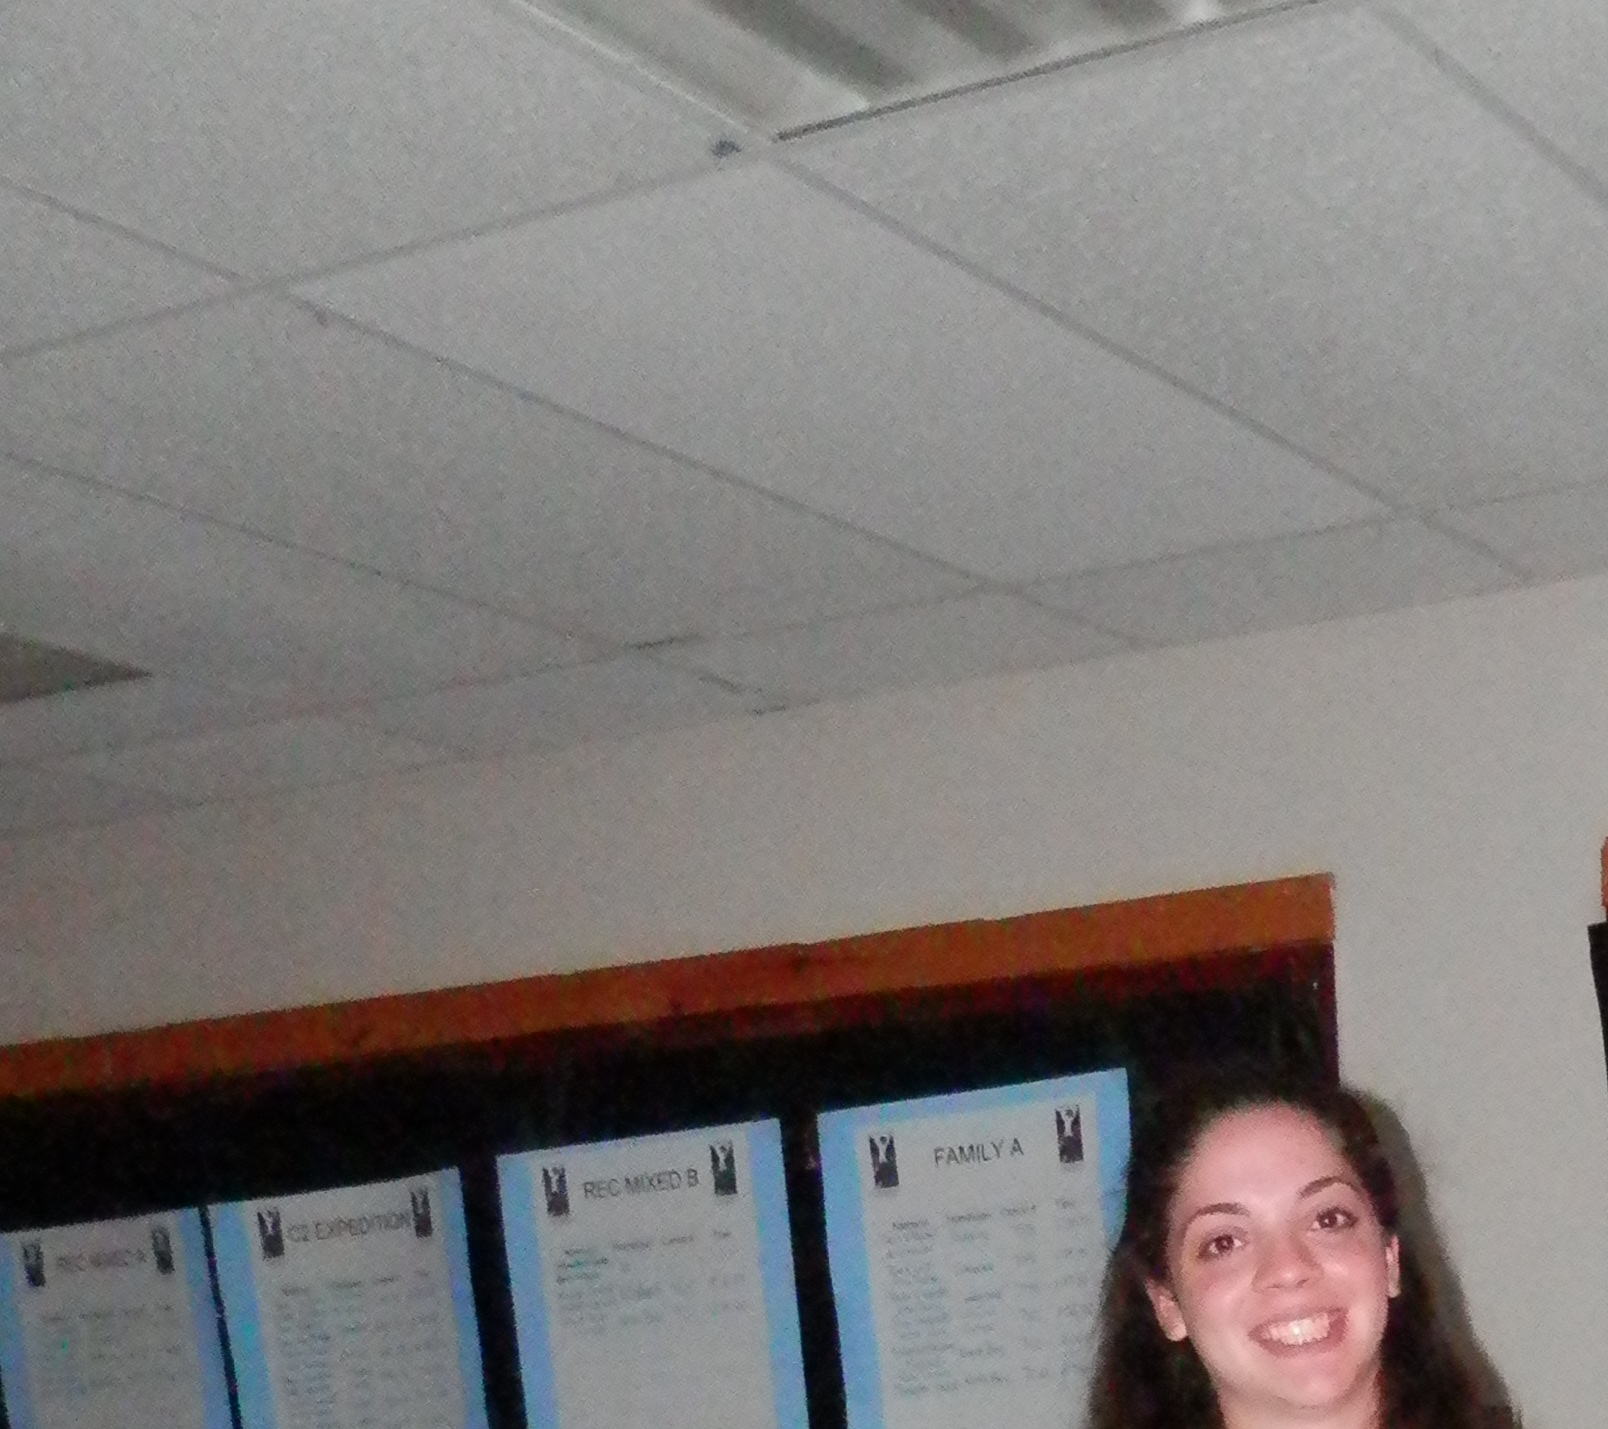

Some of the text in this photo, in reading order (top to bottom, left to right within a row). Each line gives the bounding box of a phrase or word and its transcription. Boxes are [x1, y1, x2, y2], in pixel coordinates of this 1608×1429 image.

[933, 1137, 1025, 1166] FAMILY A
[583, 1167, 700, 1200] REC MIXED B
[314, 1210, 411, 1241] EXPEDITION
